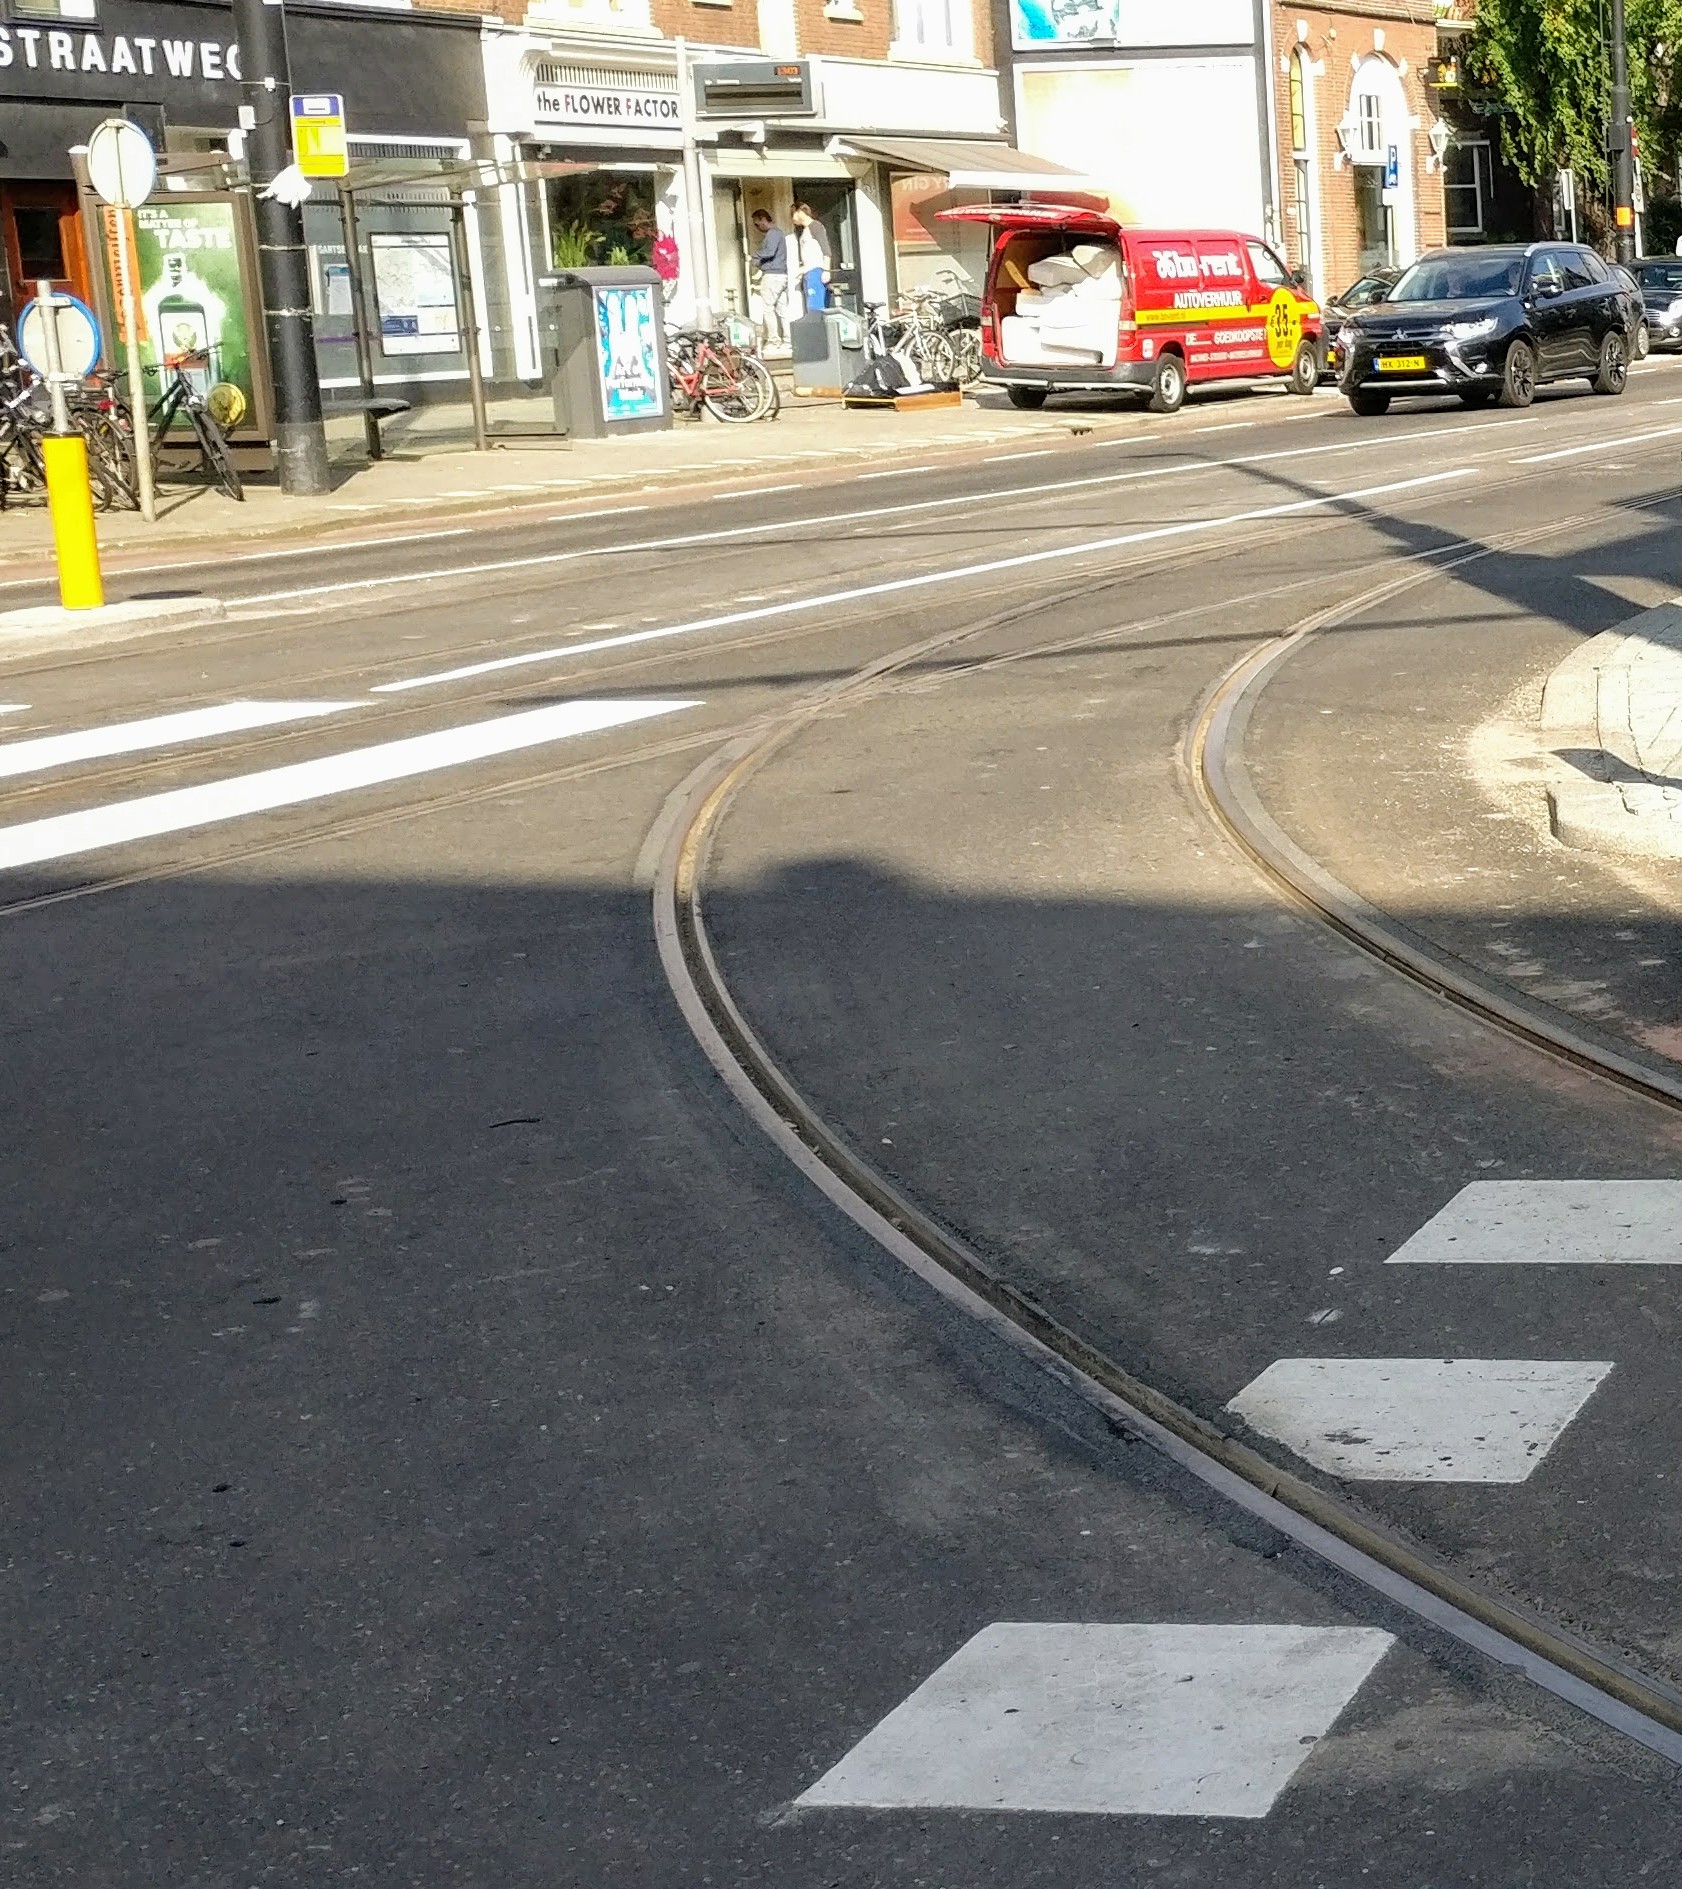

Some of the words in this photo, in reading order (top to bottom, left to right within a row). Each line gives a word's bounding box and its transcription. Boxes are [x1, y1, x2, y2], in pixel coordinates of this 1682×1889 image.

[537, 90, 560, 112] the
[564, 94, 622, 116] FLOWER
[625, 97, 680, 118] FACTOR
[160, 209, 169, 218] A
[153, 228, 232, 248] TASTE
[1174, 290, 1243, 309] AUTOVERHUUR
